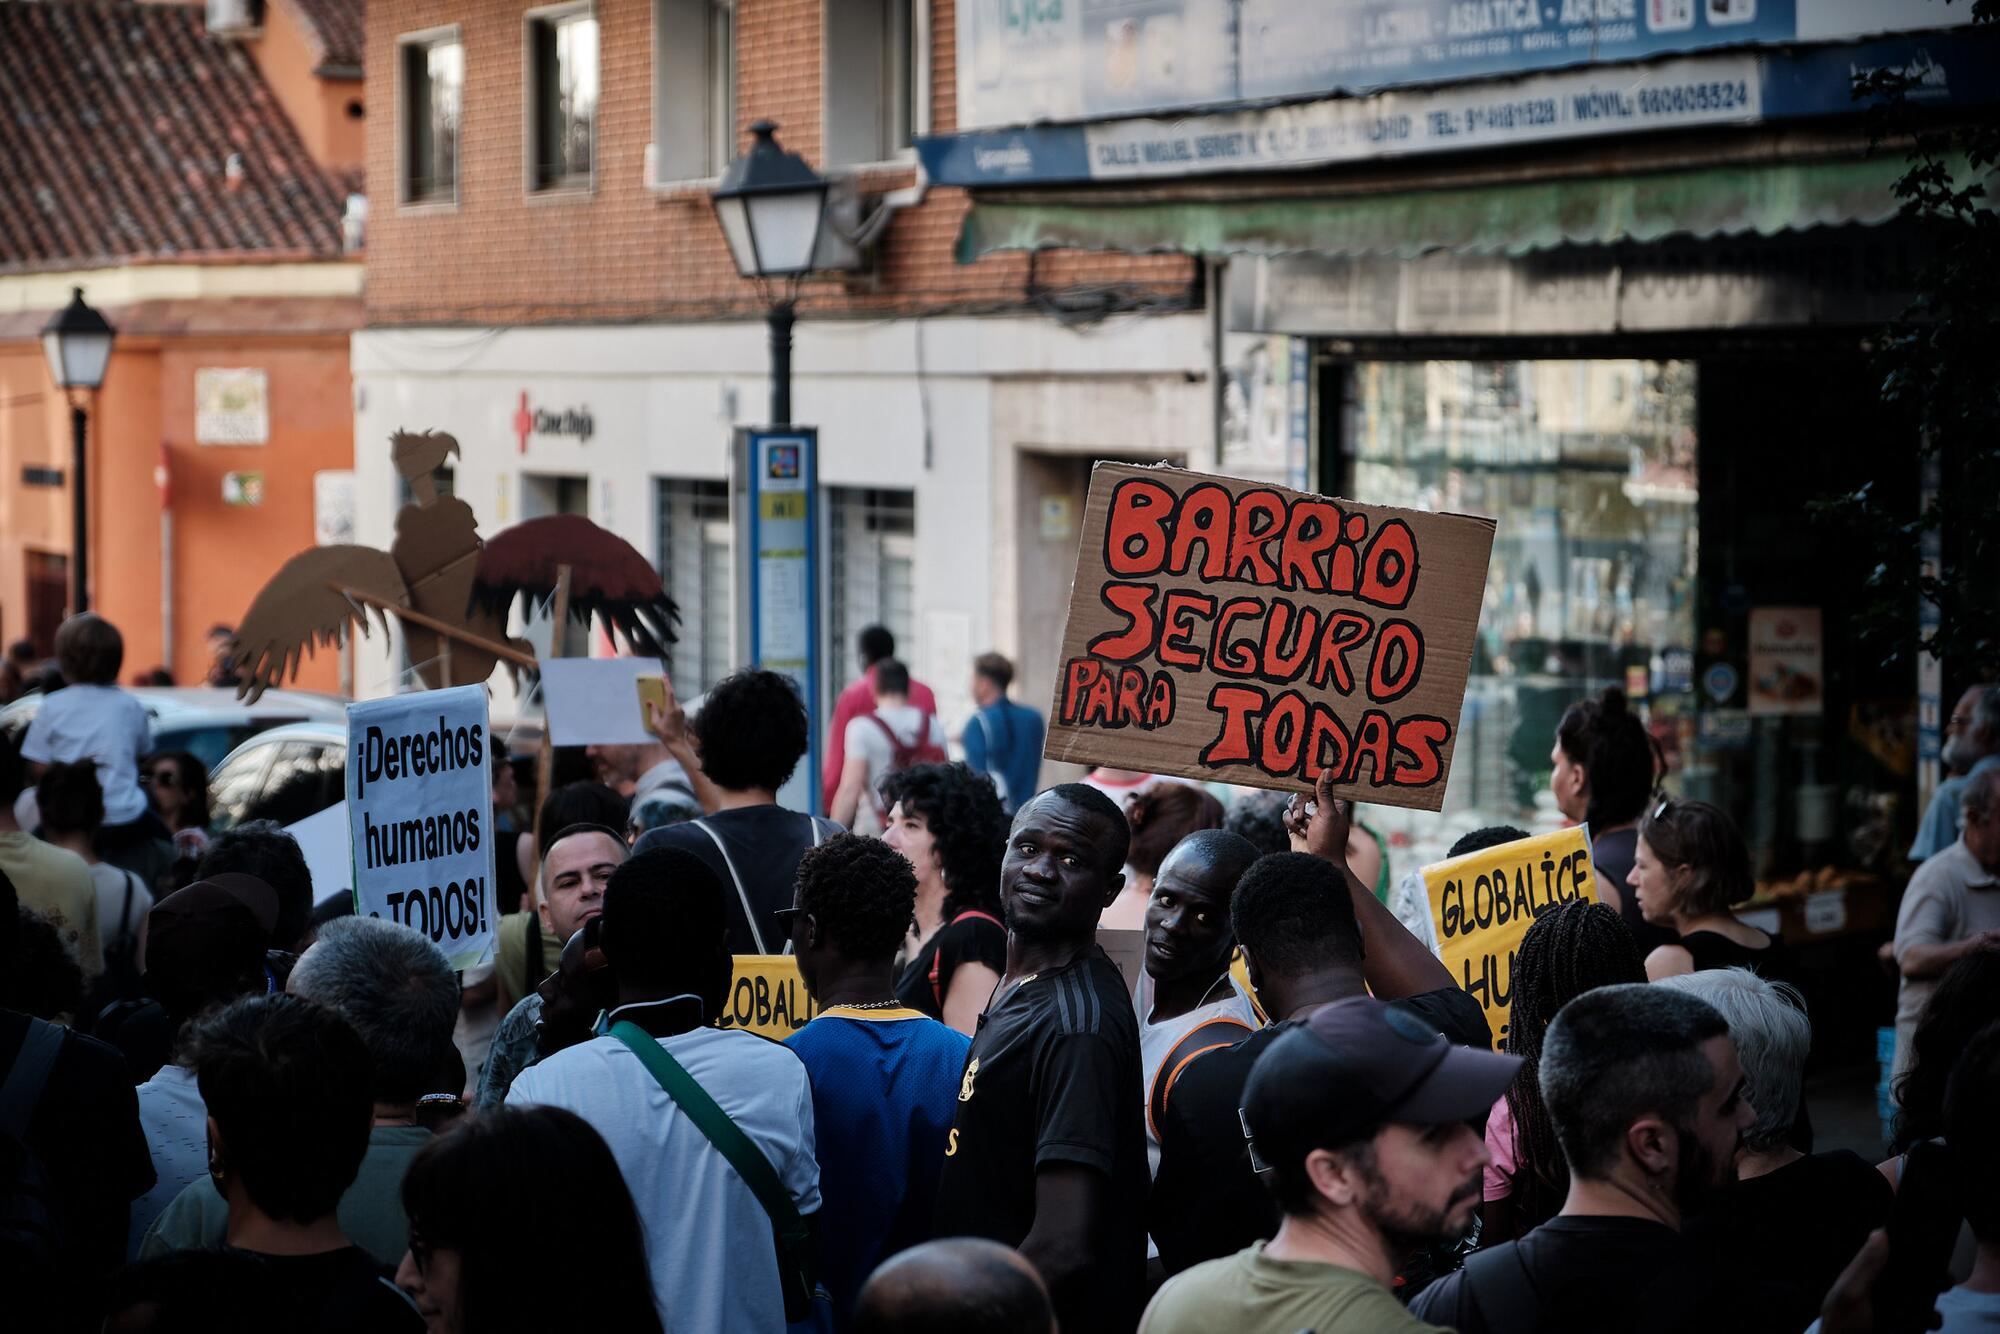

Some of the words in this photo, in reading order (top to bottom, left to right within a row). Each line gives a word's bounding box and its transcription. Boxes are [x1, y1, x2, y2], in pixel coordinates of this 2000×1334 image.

[1086, 581, 1425, 704] SEGURO
[358, 715, 483, 800] ¡Derechos
[1059, 657, 1176, 730] PARA
[1199, 682, 1452, 787] TODAS
[364, 808, 480, 870] humanos
